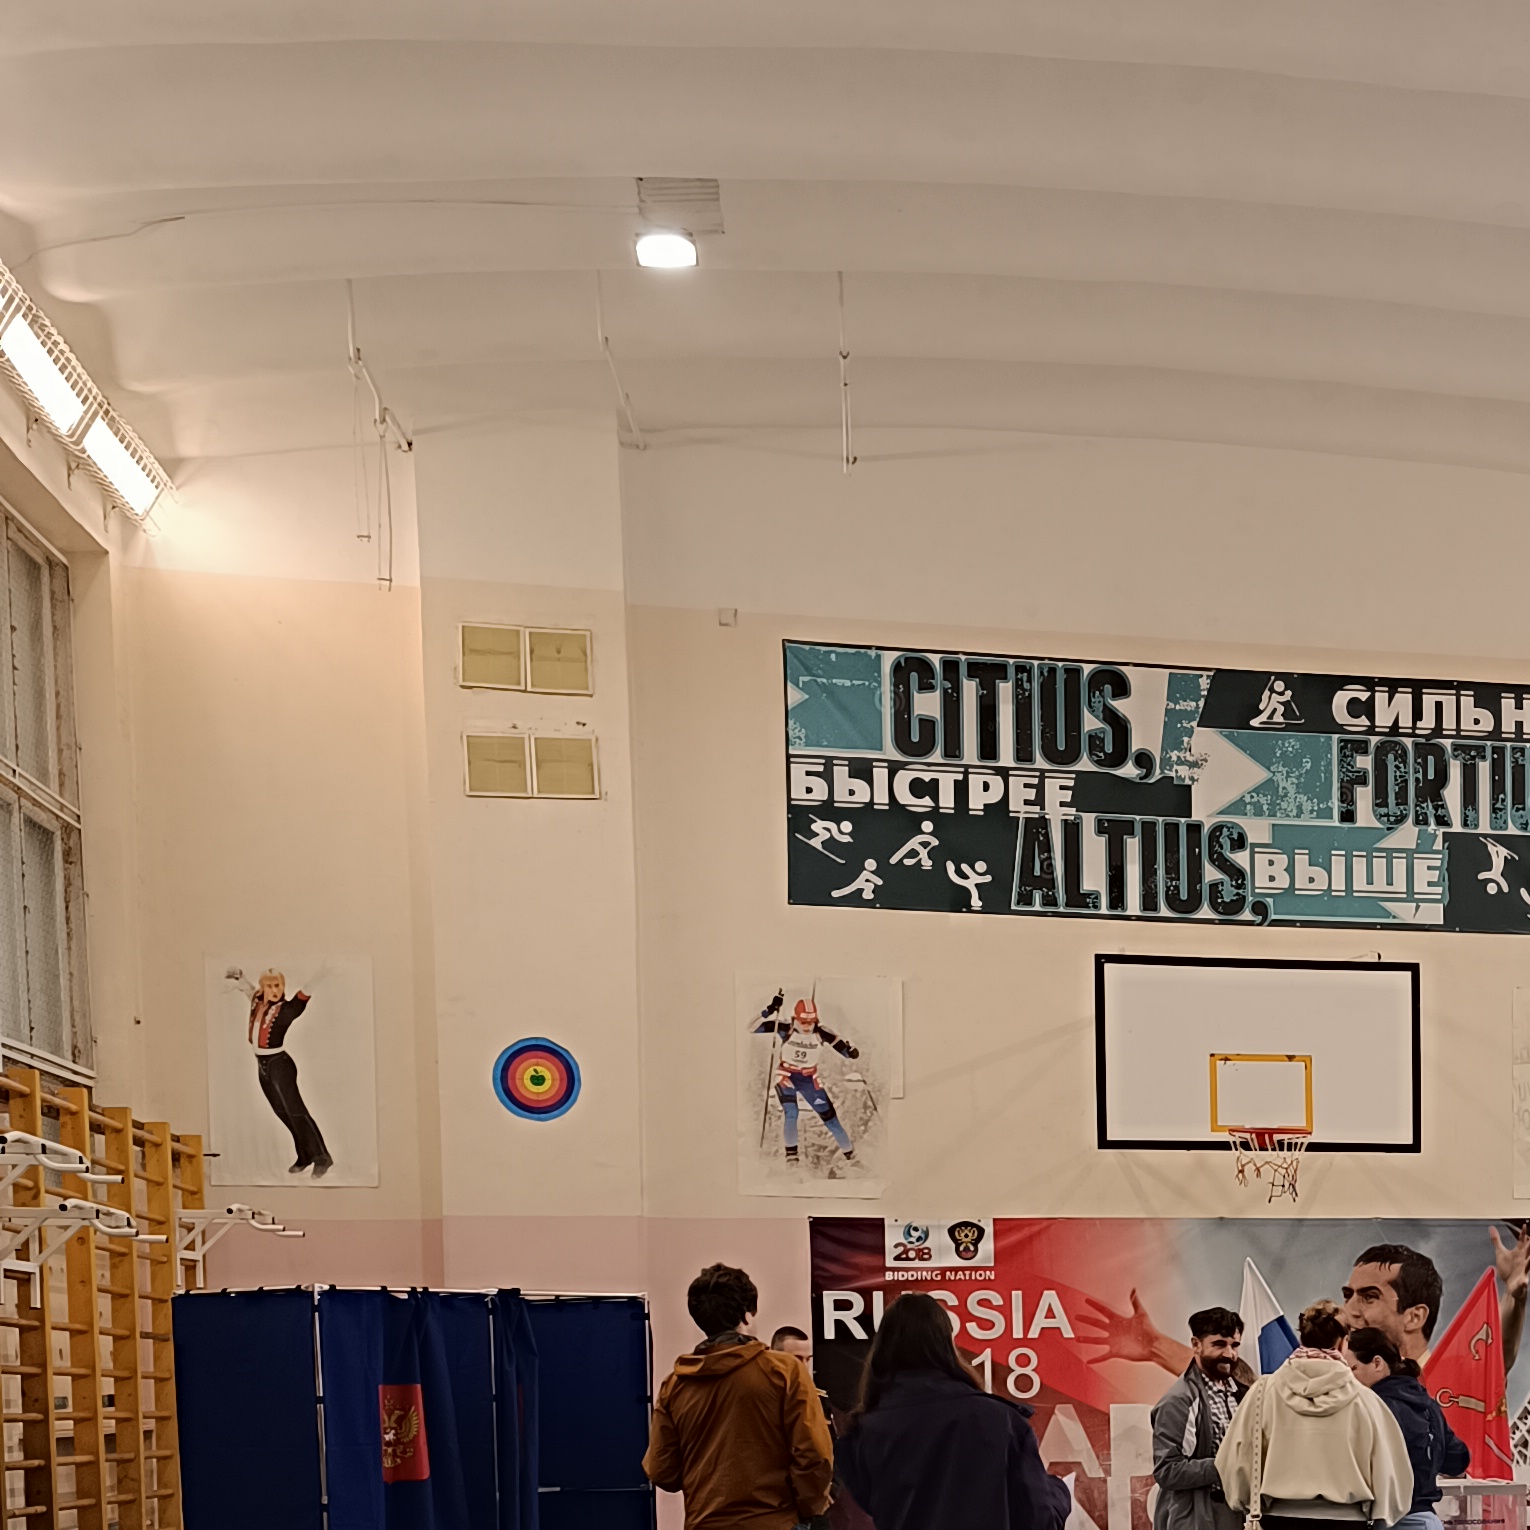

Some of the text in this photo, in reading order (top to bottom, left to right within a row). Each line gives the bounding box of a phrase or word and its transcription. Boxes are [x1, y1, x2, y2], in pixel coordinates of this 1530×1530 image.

[889, 652, 1157, 782] CITIUS,
[790, 757, 1077, 818] БЫСТРЕЕ
[1013, 814, 1273, 926] ALTIUS,
[1254, 847, 1443, 899] ВЫШЕ
[794, 1050, 807, 1059] 59
[885, 1270, 995, 1281] BIDDING NATION
[971, 1348, 1041, 1398] 18
